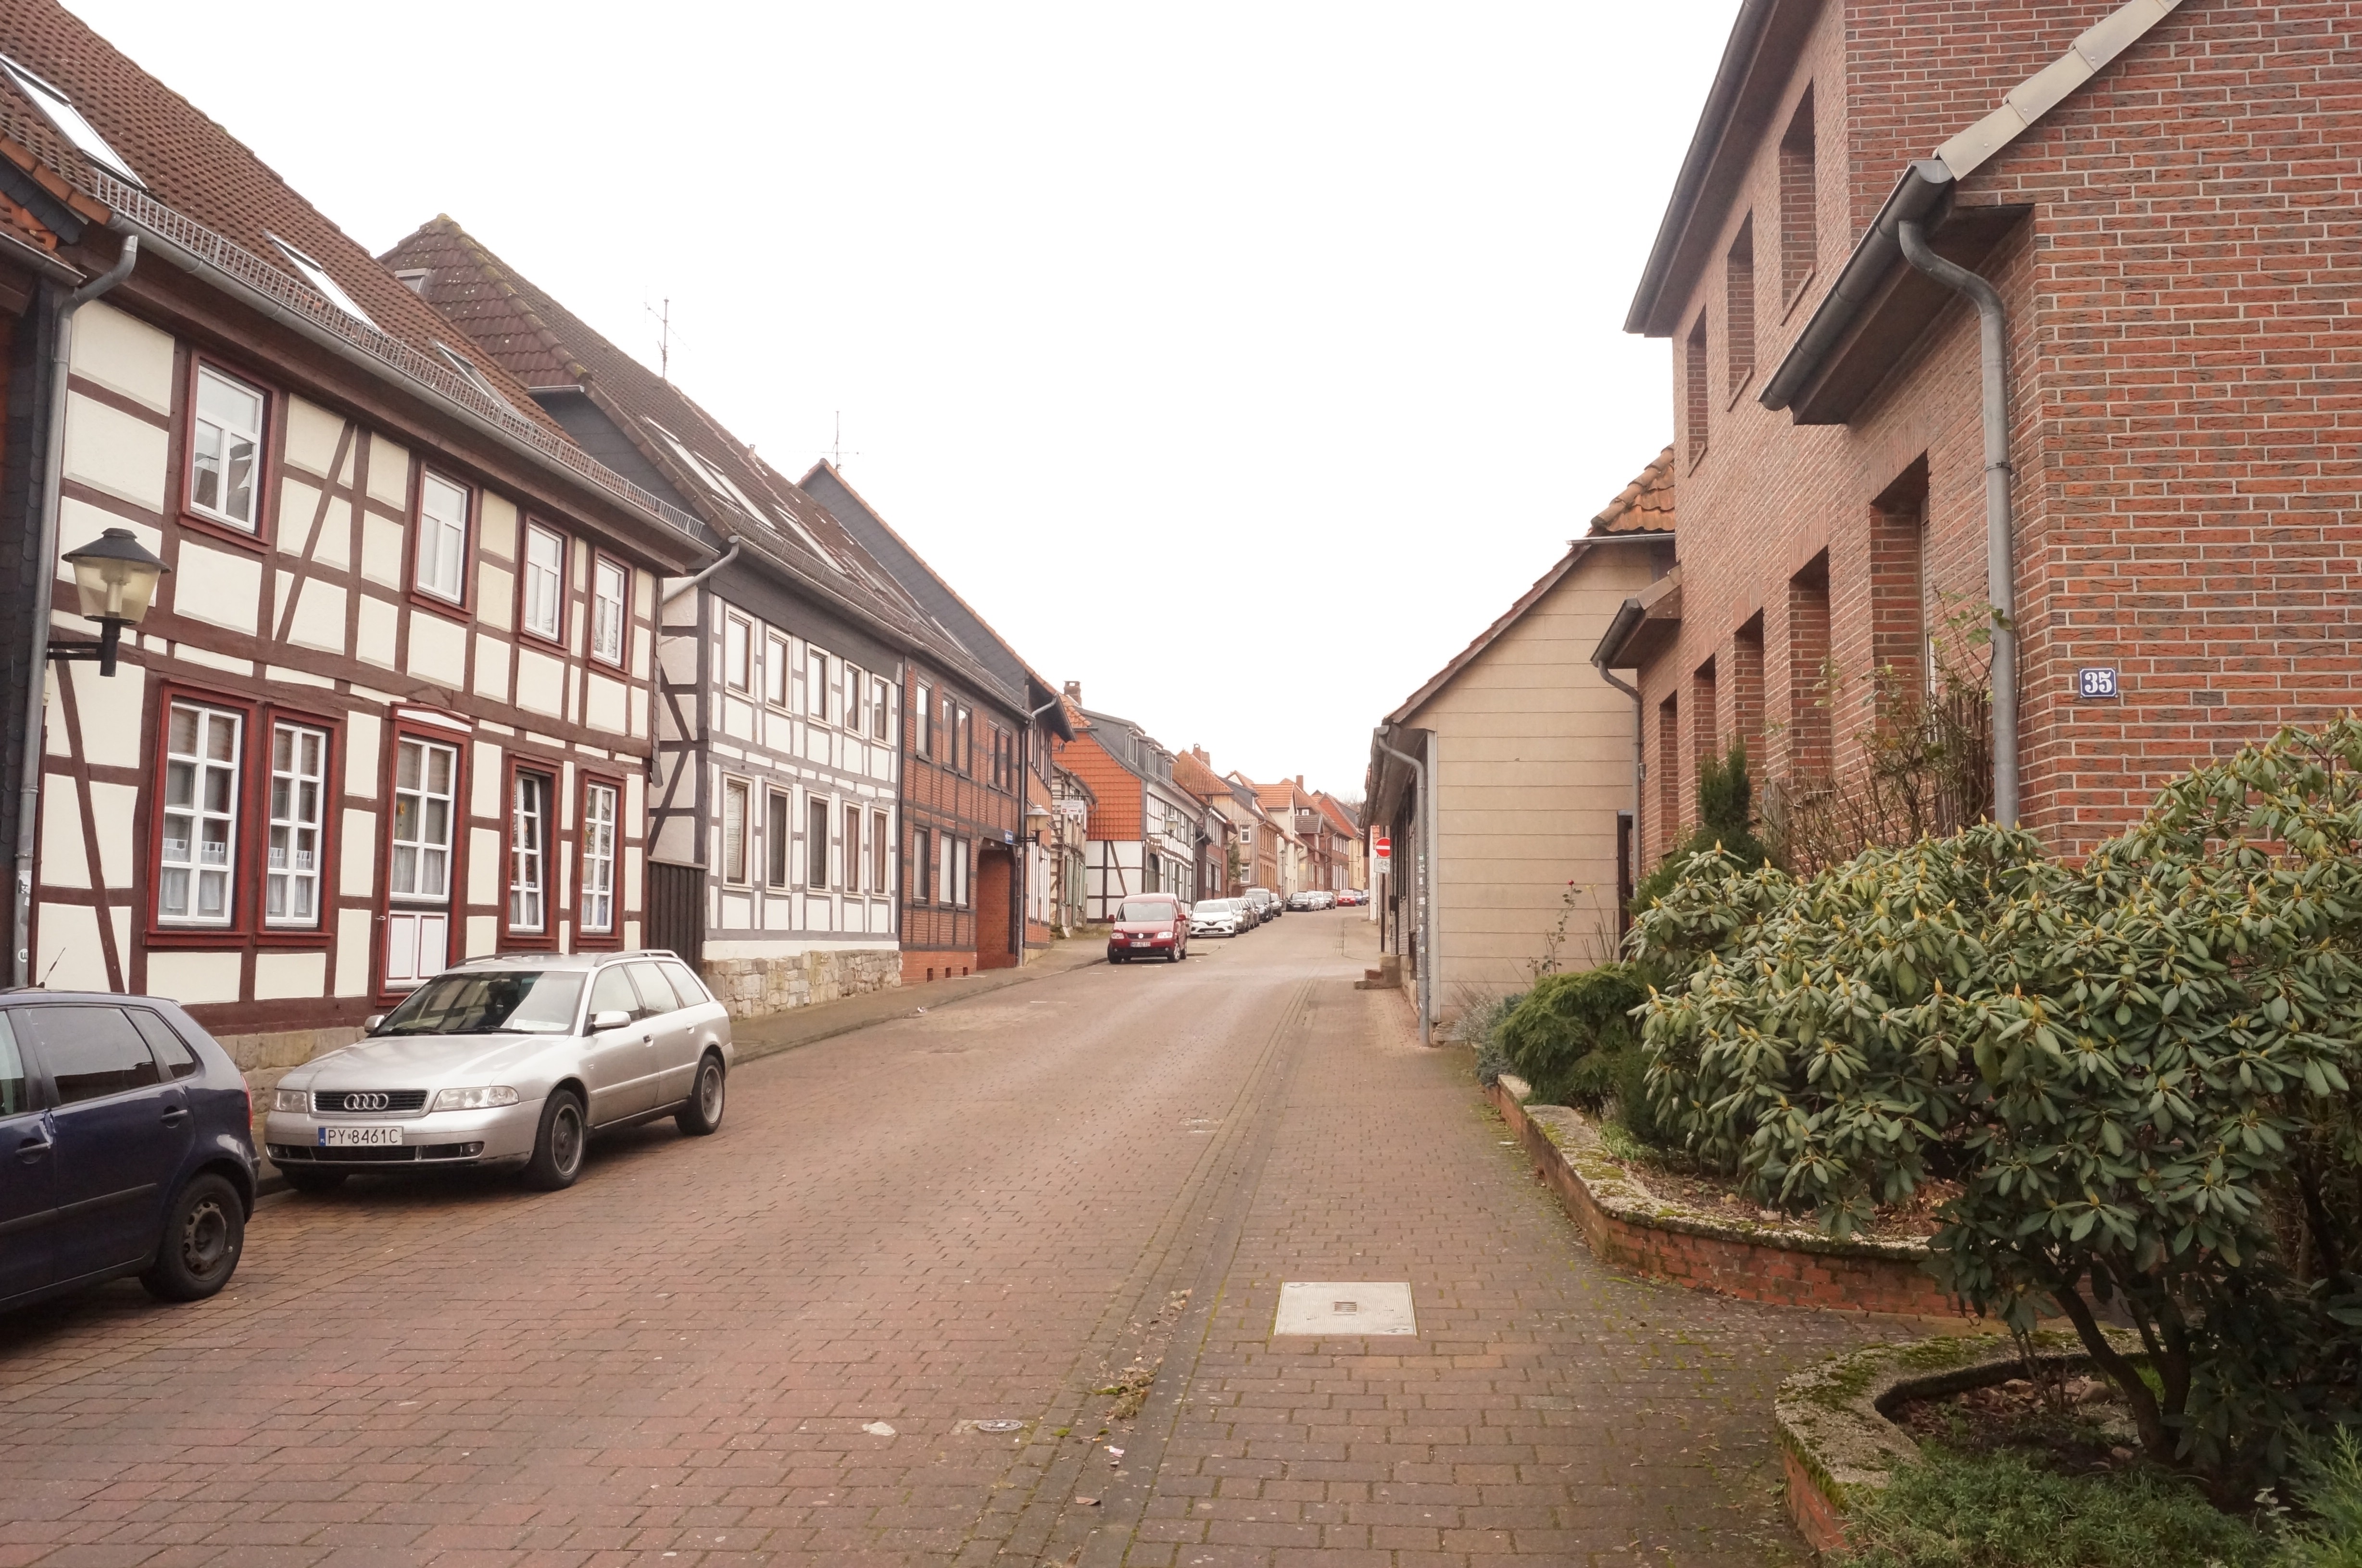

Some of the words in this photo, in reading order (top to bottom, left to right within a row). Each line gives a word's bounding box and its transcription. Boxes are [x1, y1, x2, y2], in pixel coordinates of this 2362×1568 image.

[2085, 672, 2112, 693] 35
[328, 1129, 346, 1144] PY
[352, 1129, 398, 1144] 8461C
